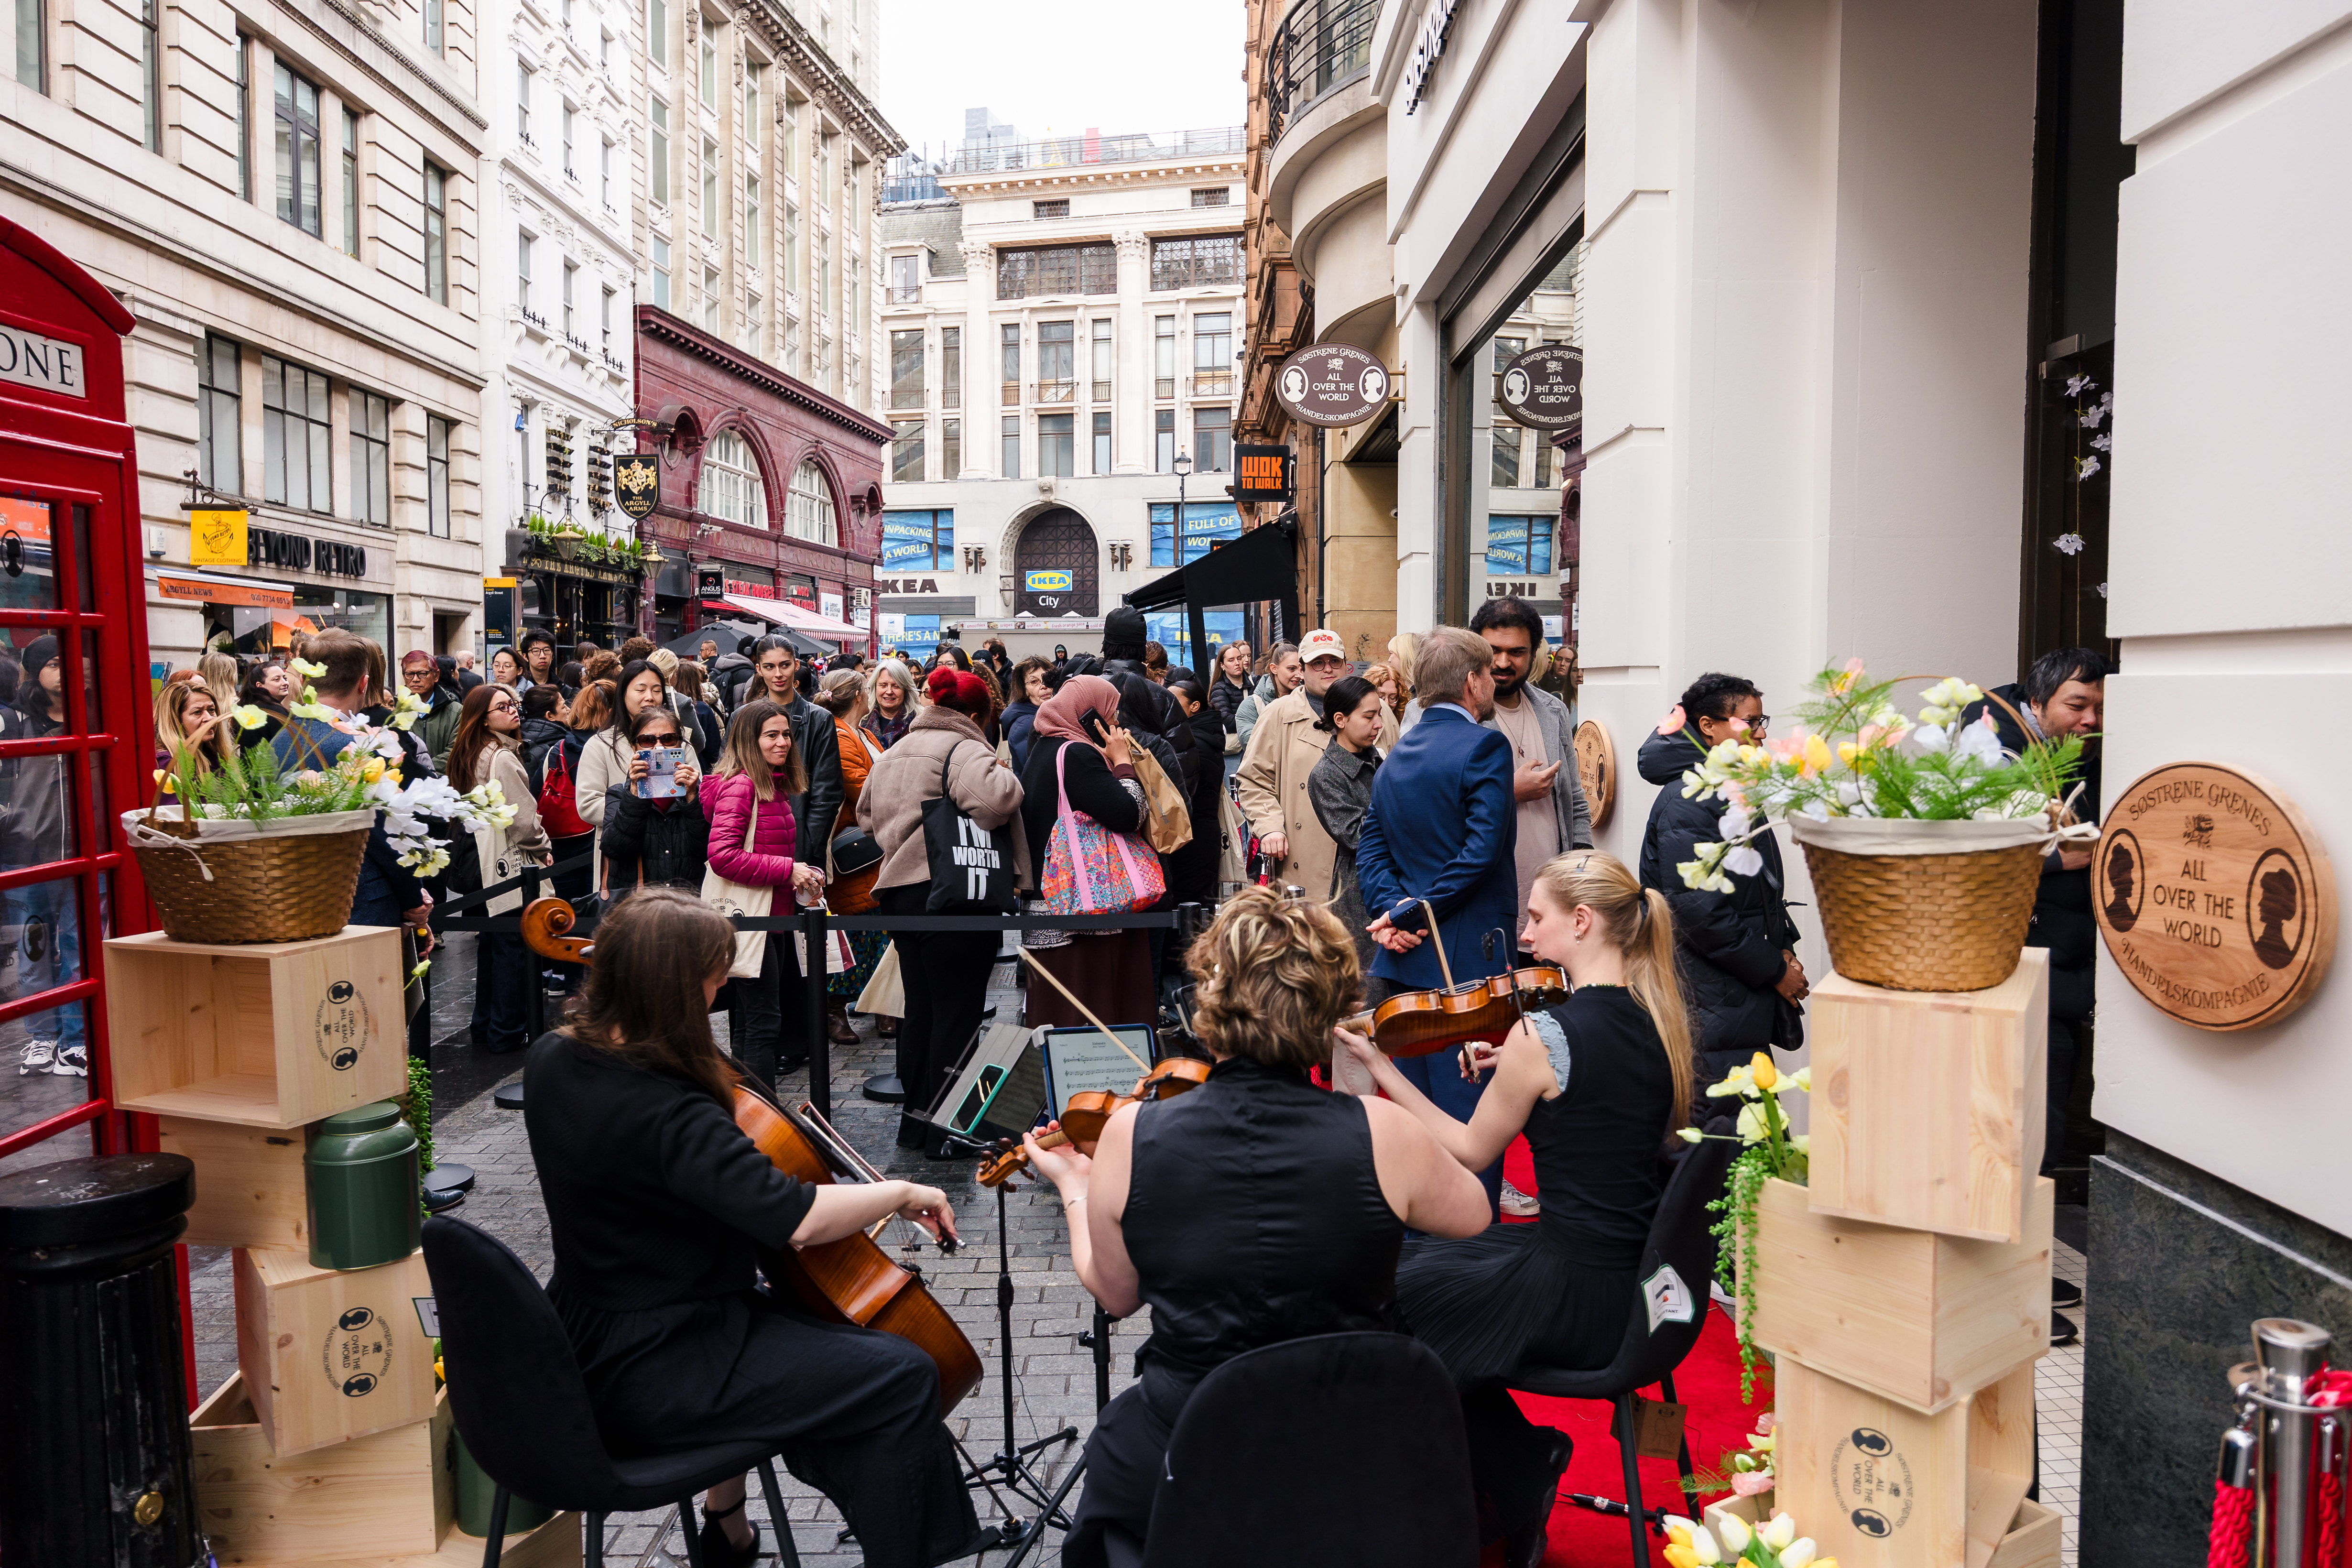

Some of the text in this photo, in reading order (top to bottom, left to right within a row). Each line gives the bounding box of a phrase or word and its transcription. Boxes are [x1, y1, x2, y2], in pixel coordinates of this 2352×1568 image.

[1297, 348, 1371, 364] SØSTRENE GRENES
[1312, 383, 1336, 391] OVER
[1295, 403, 1372, 421] HANDELSKOMPAGNIE
[612, 418, 657, 429] NICHOLSON'S
[1241, 457, 1282, 477] WOK
[1241, 478, 1282, 489] TO WALK
[1189, 515, 1234, 531] FULL OF
[713, 530, 766, 555] OXFORD
[885, 543, 928, 560] A WORLD
[315, 540, 366, 577] RETRO
[544, 556, 562, 572] THE
[564, 561, 595, 578] ARGYLL
[795, 548, 837, 571] CIRCUS
[166, 585, 212, 597] ARGYLL NEWS
[731, 580, 750, 596] STEAK
[752, 584, 774, 599] HOUSES
[1031, 577, 1067, 585] IKEA
[262, 595, 275, 603] 7734
[276, 596, 290, 605] 6515
[1039, 596, 1059, 609] City
[924, 631, 931, 641] A
[2129, 781, 2271, 836] SØSTRENE GRENES
[952, 846, 1001, 869] WORTH
[2180, 859, 2207, 881] ALL
[968, 867, 989, 900] IT
[2153, 884, 2235, 920] OVER THE
[2163, 917, 2222, 948] WORLD
[2122, 937, 2270, 1009] HANDELSKOMPAGNIE
[342, 1341, 350, 1368] WORLD
[351, 1335, 361, 1371] OVER THE
[361, 1345, 370, 1357] ALL
[1853, 1463, 1862, 1495] WORLD
[1864, 1460, 1873, 1504] OVER THE
[1876, 1477, 1885, 1492] ALL
